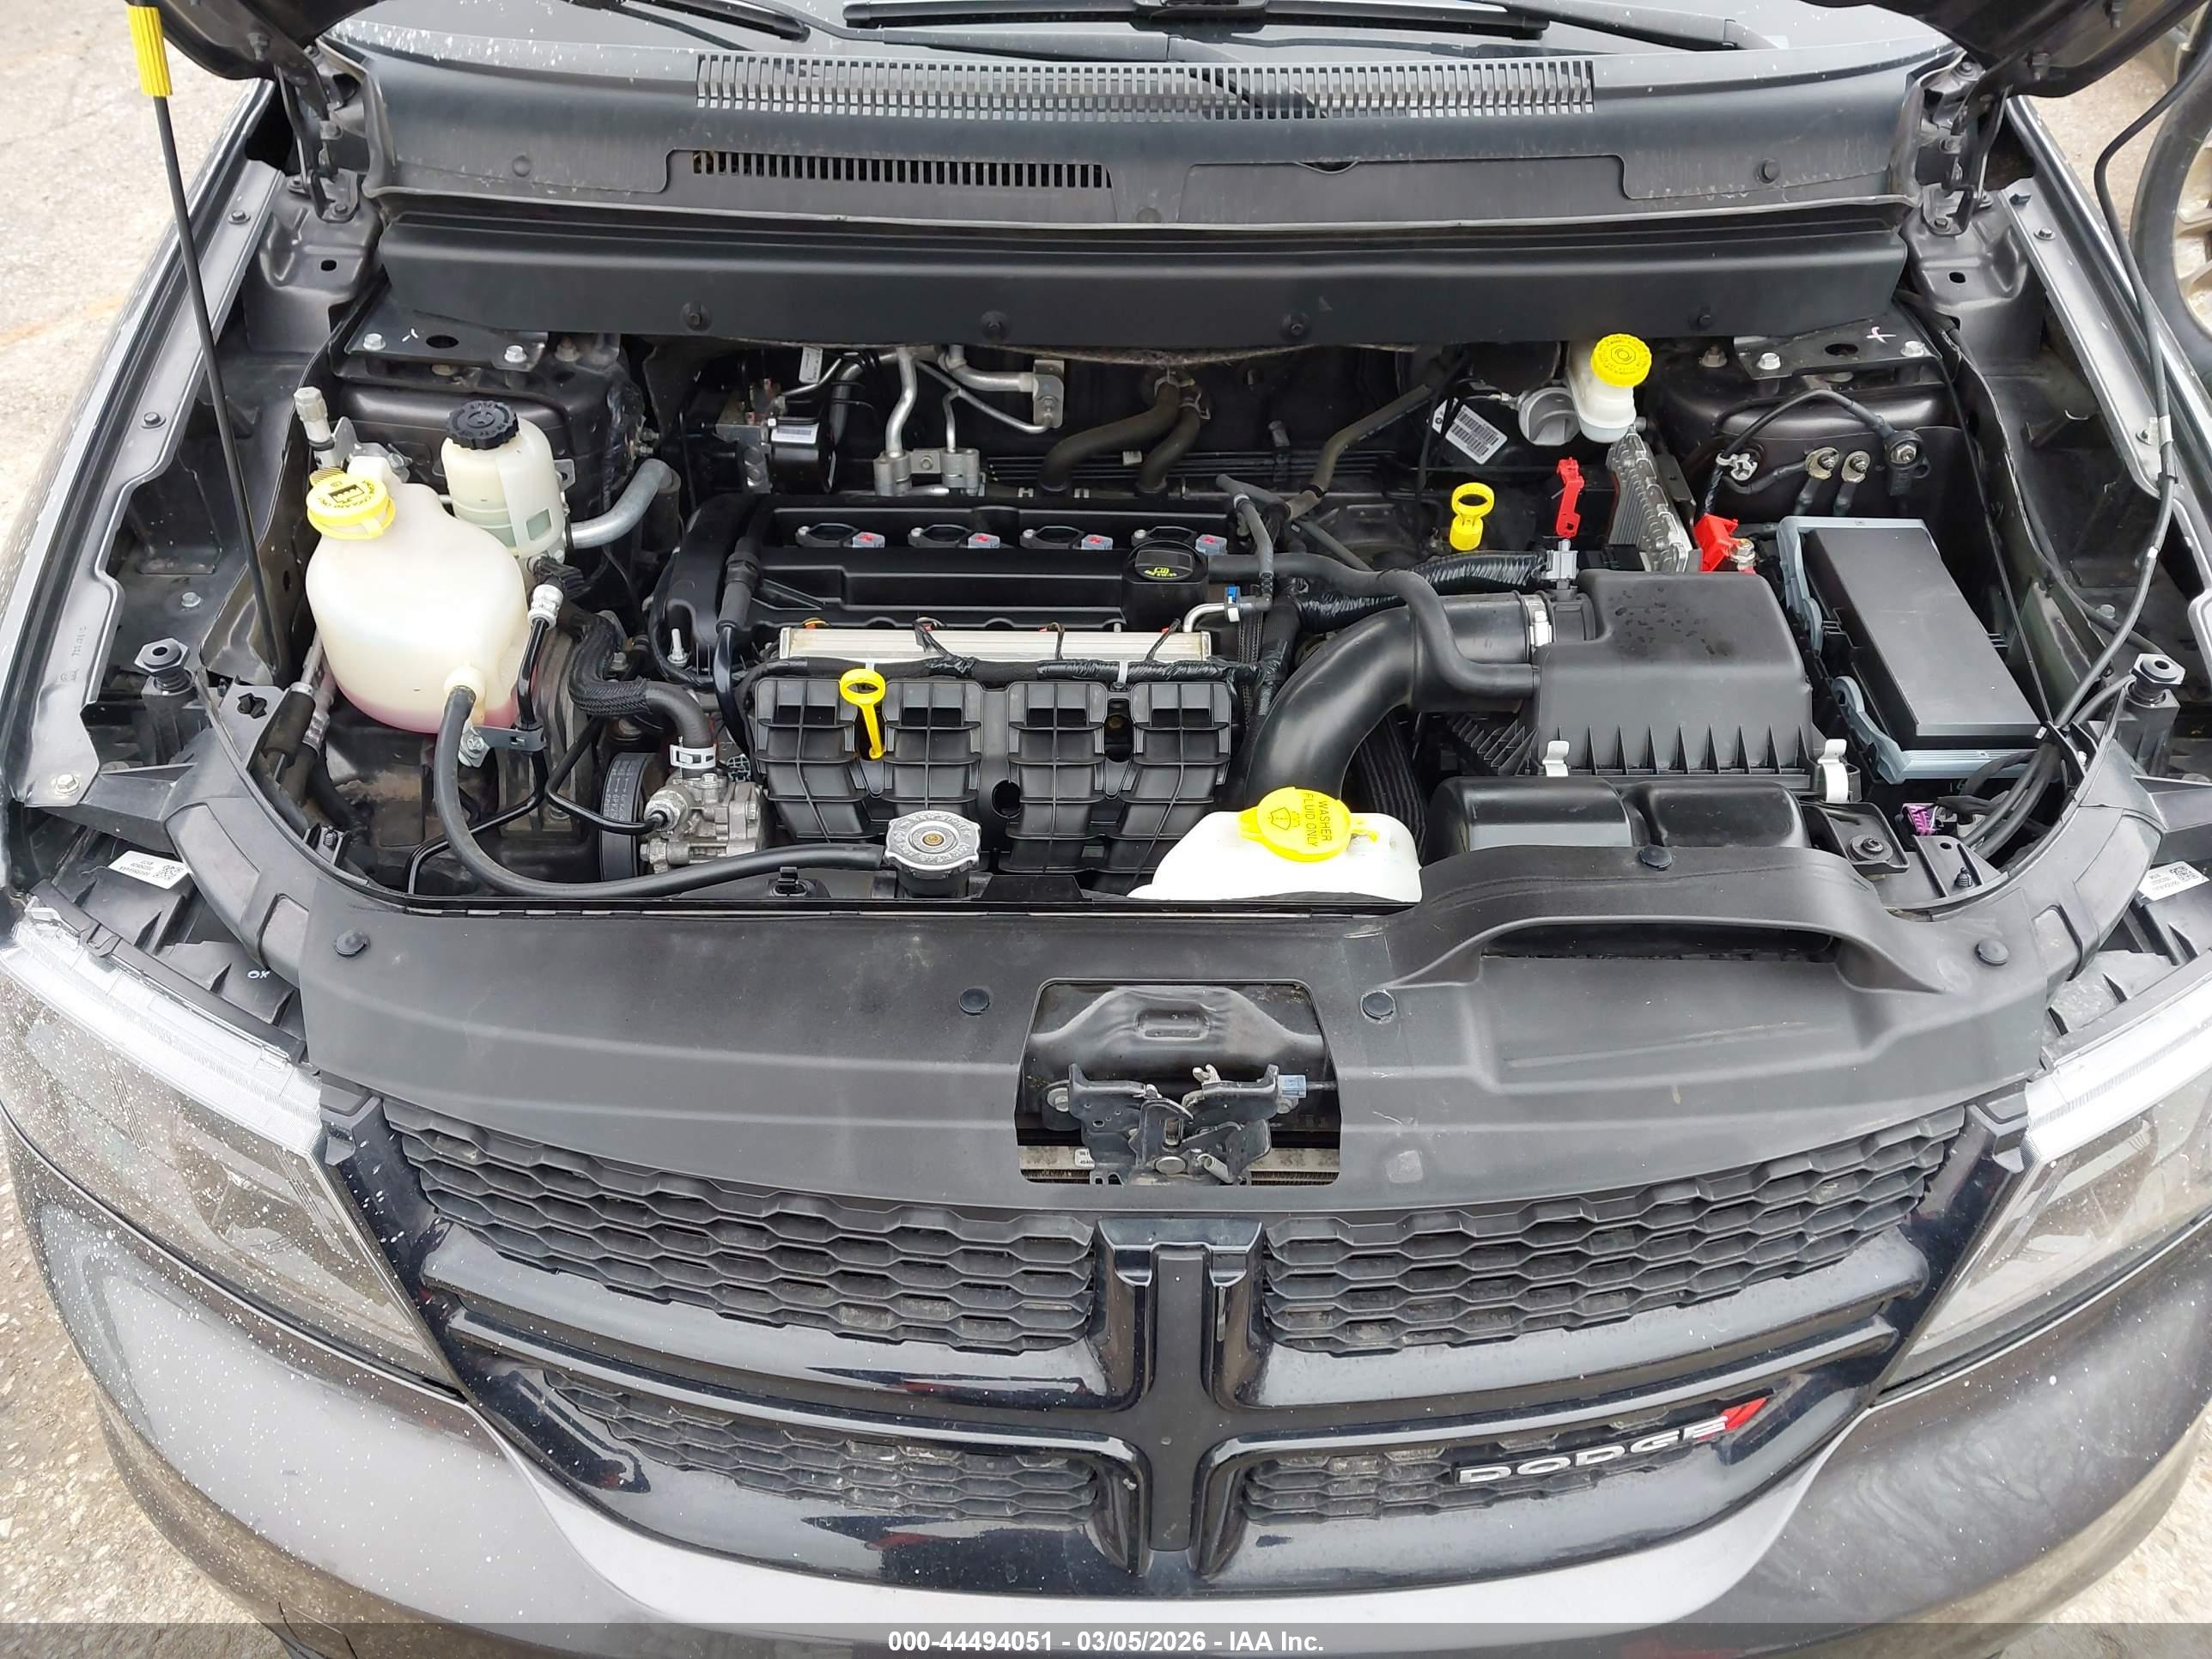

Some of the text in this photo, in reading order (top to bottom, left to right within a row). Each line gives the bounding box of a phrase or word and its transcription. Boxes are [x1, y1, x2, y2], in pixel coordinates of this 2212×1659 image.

[1304, 793, 1319, 848] FLUID ONLY
[1318, 800, 1332, 842] WASHER
[1459, 1415, 1729, 1484] DODGE
